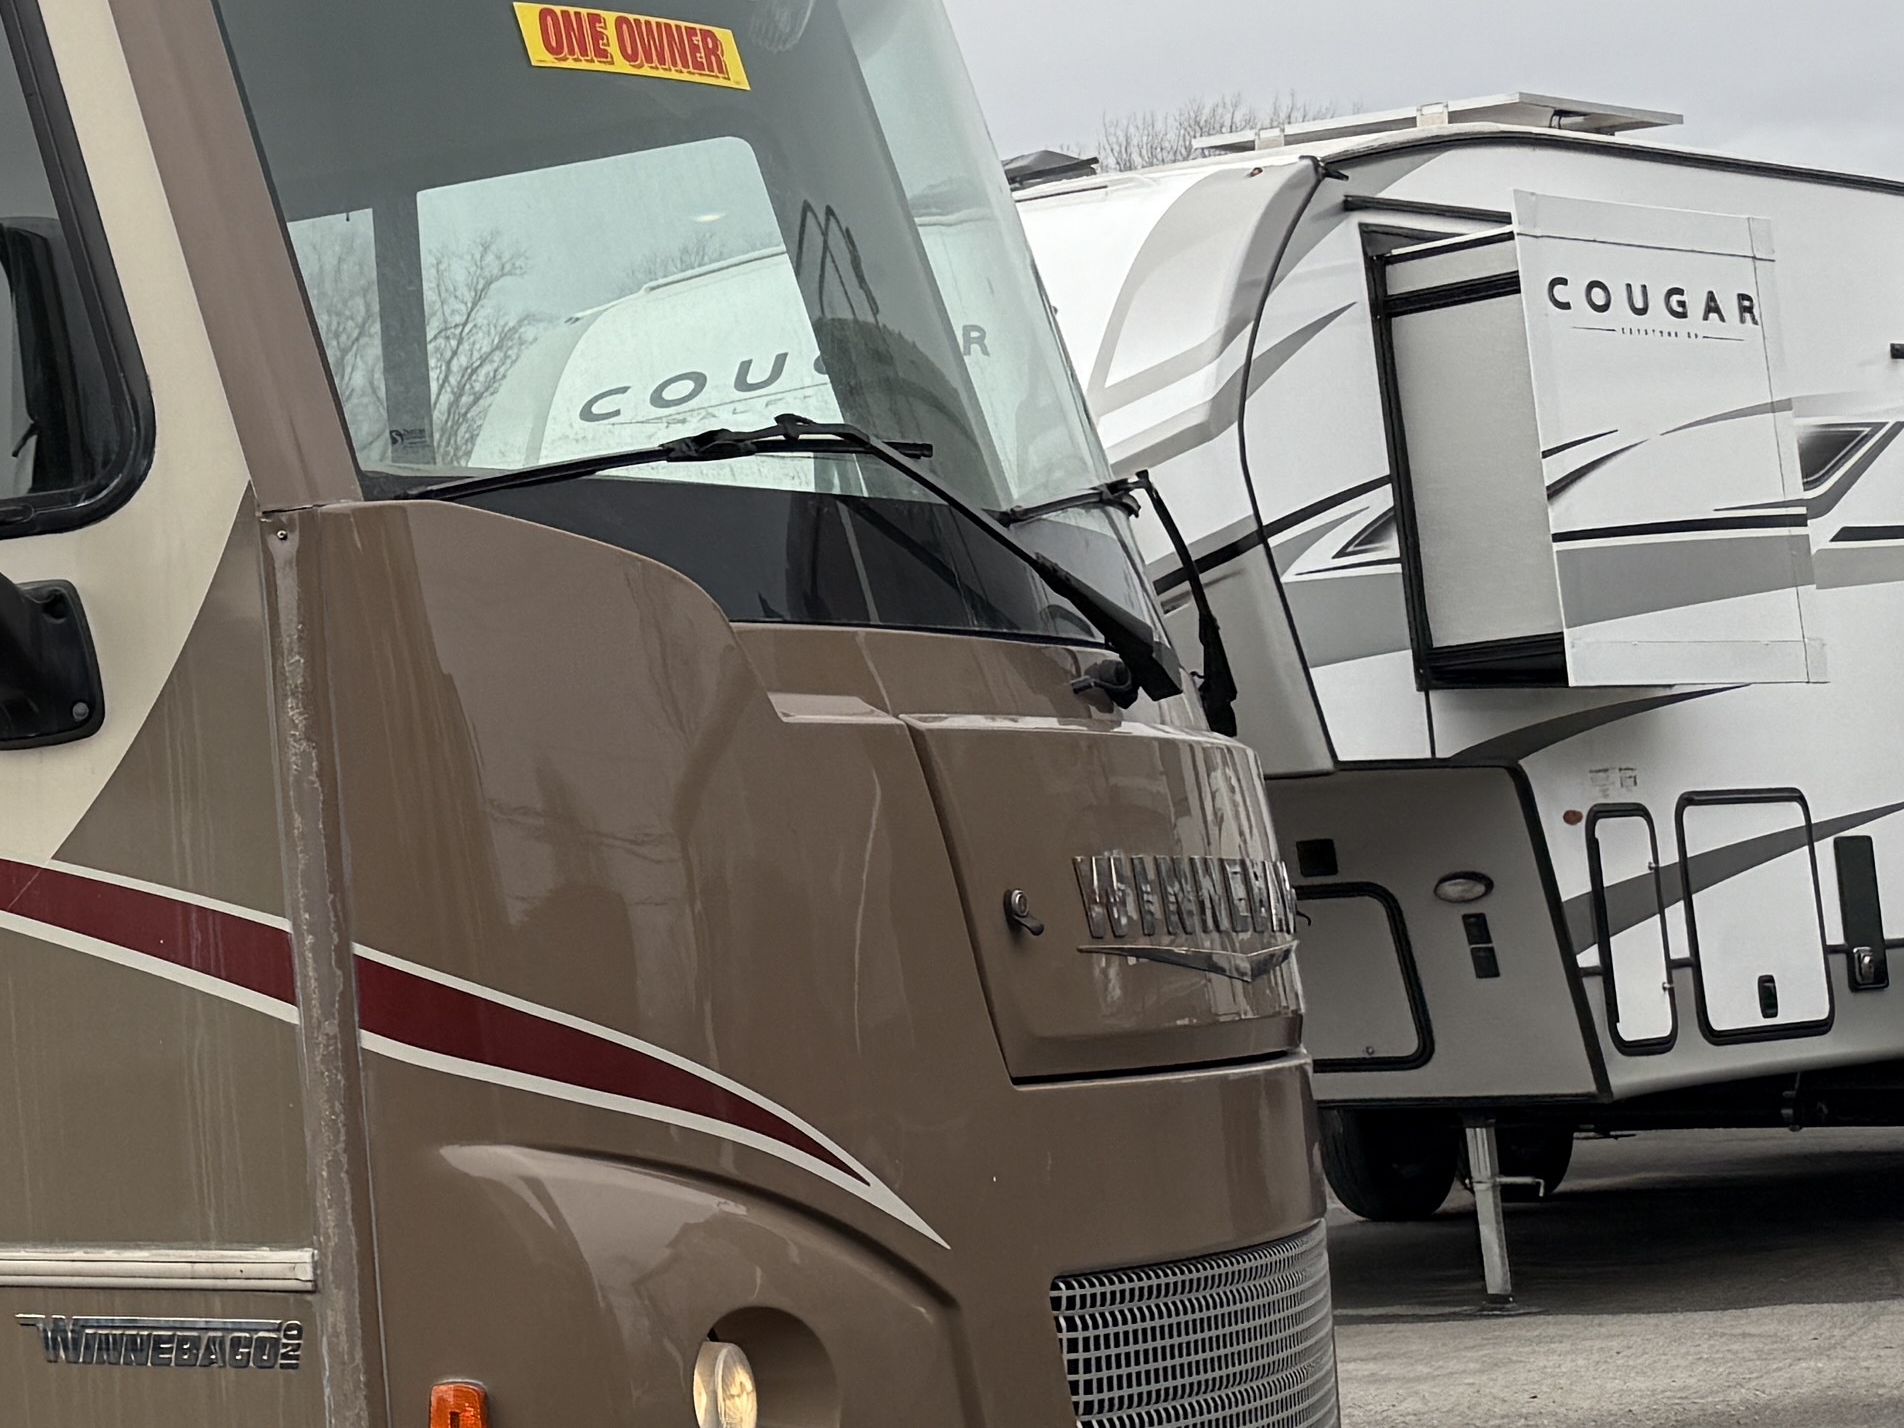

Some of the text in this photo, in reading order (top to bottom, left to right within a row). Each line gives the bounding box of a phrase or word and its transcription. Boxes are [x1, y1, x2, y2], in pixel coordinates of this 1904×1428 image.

[538, 7, 731, 81] ONE OWNER
[1547, 276, 1760, 326] COUGAR
[16, 1314, 282, 1369] WINNEBAGO
